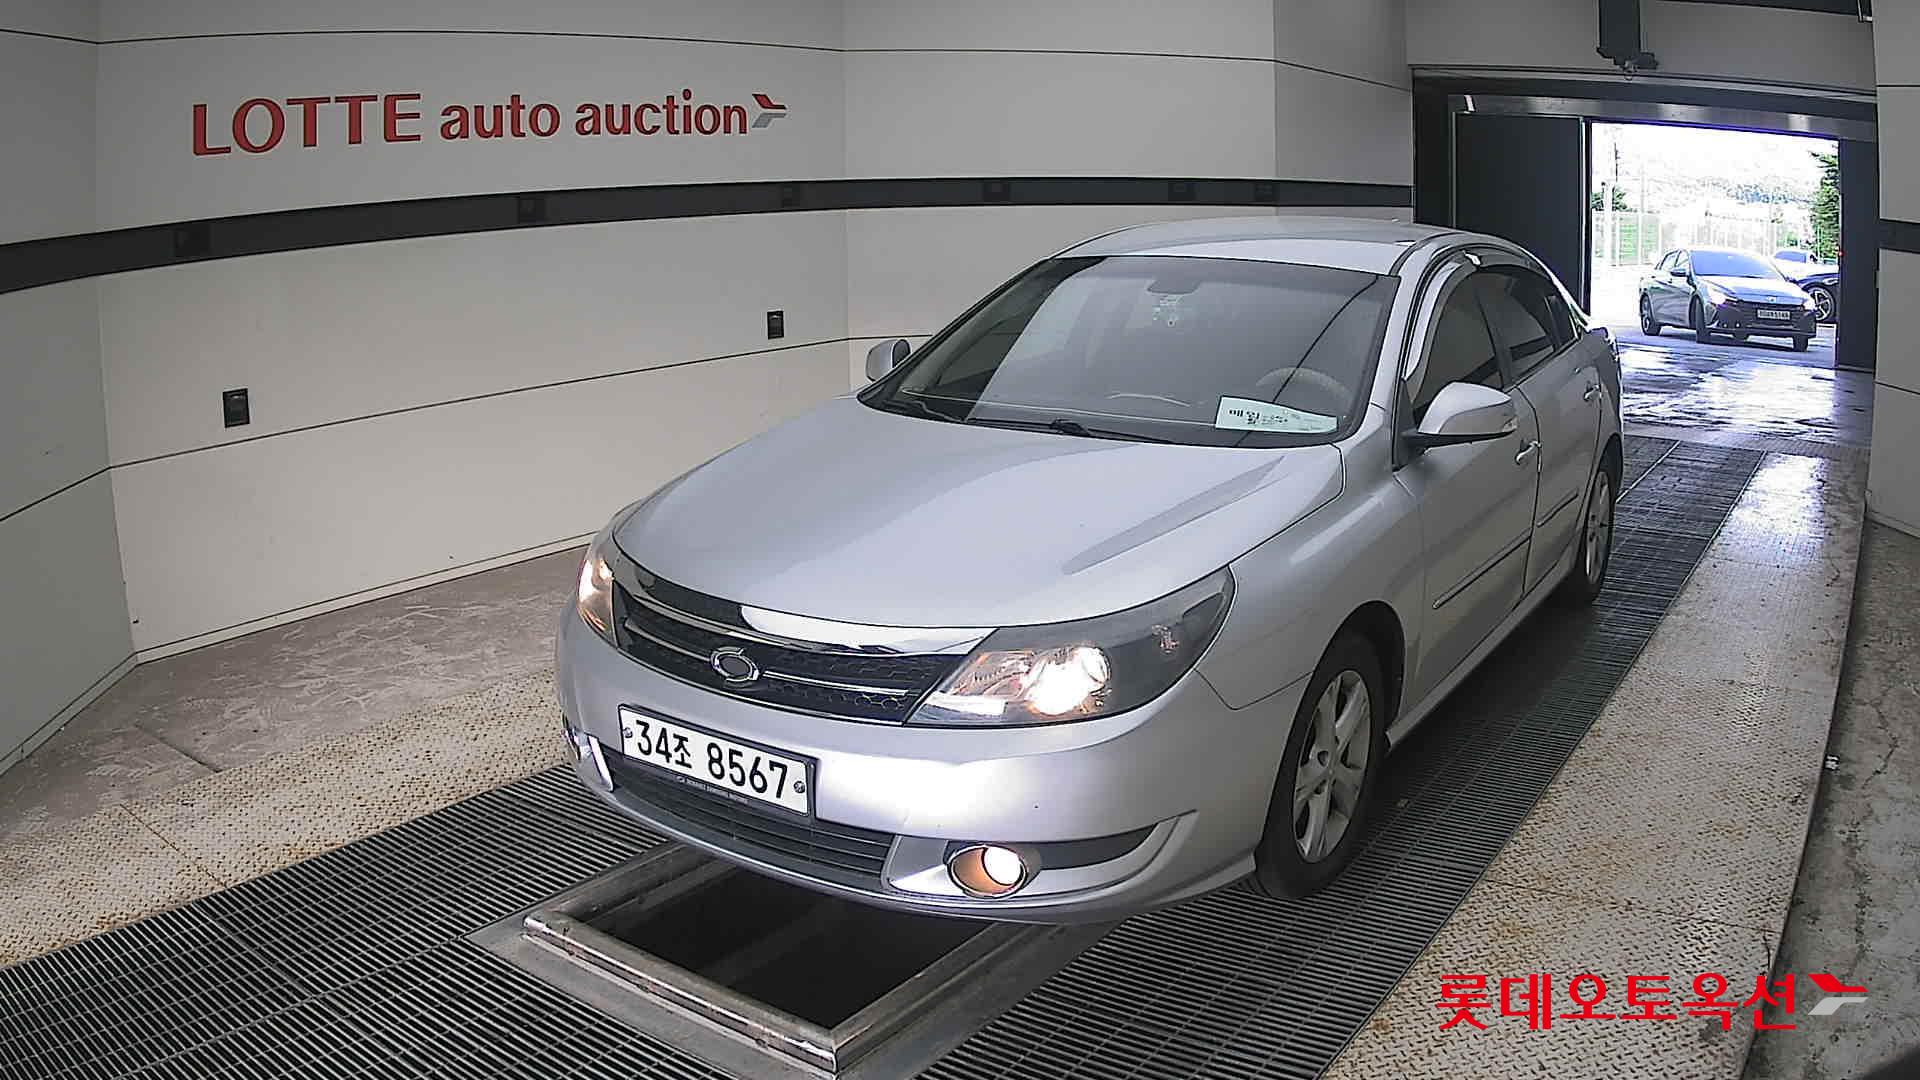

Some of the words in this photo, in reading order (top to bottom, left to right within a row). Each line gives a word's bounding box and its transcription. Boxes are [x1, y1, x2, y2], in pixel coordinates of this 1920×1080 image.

[193, 92, 421, 156] LOTTE
[440, 93, 561, 141] auto
[574, 88, 749, 136] auction
[635, 719, 693, 769] 34조
[706, 742, 788, 799] 8567
